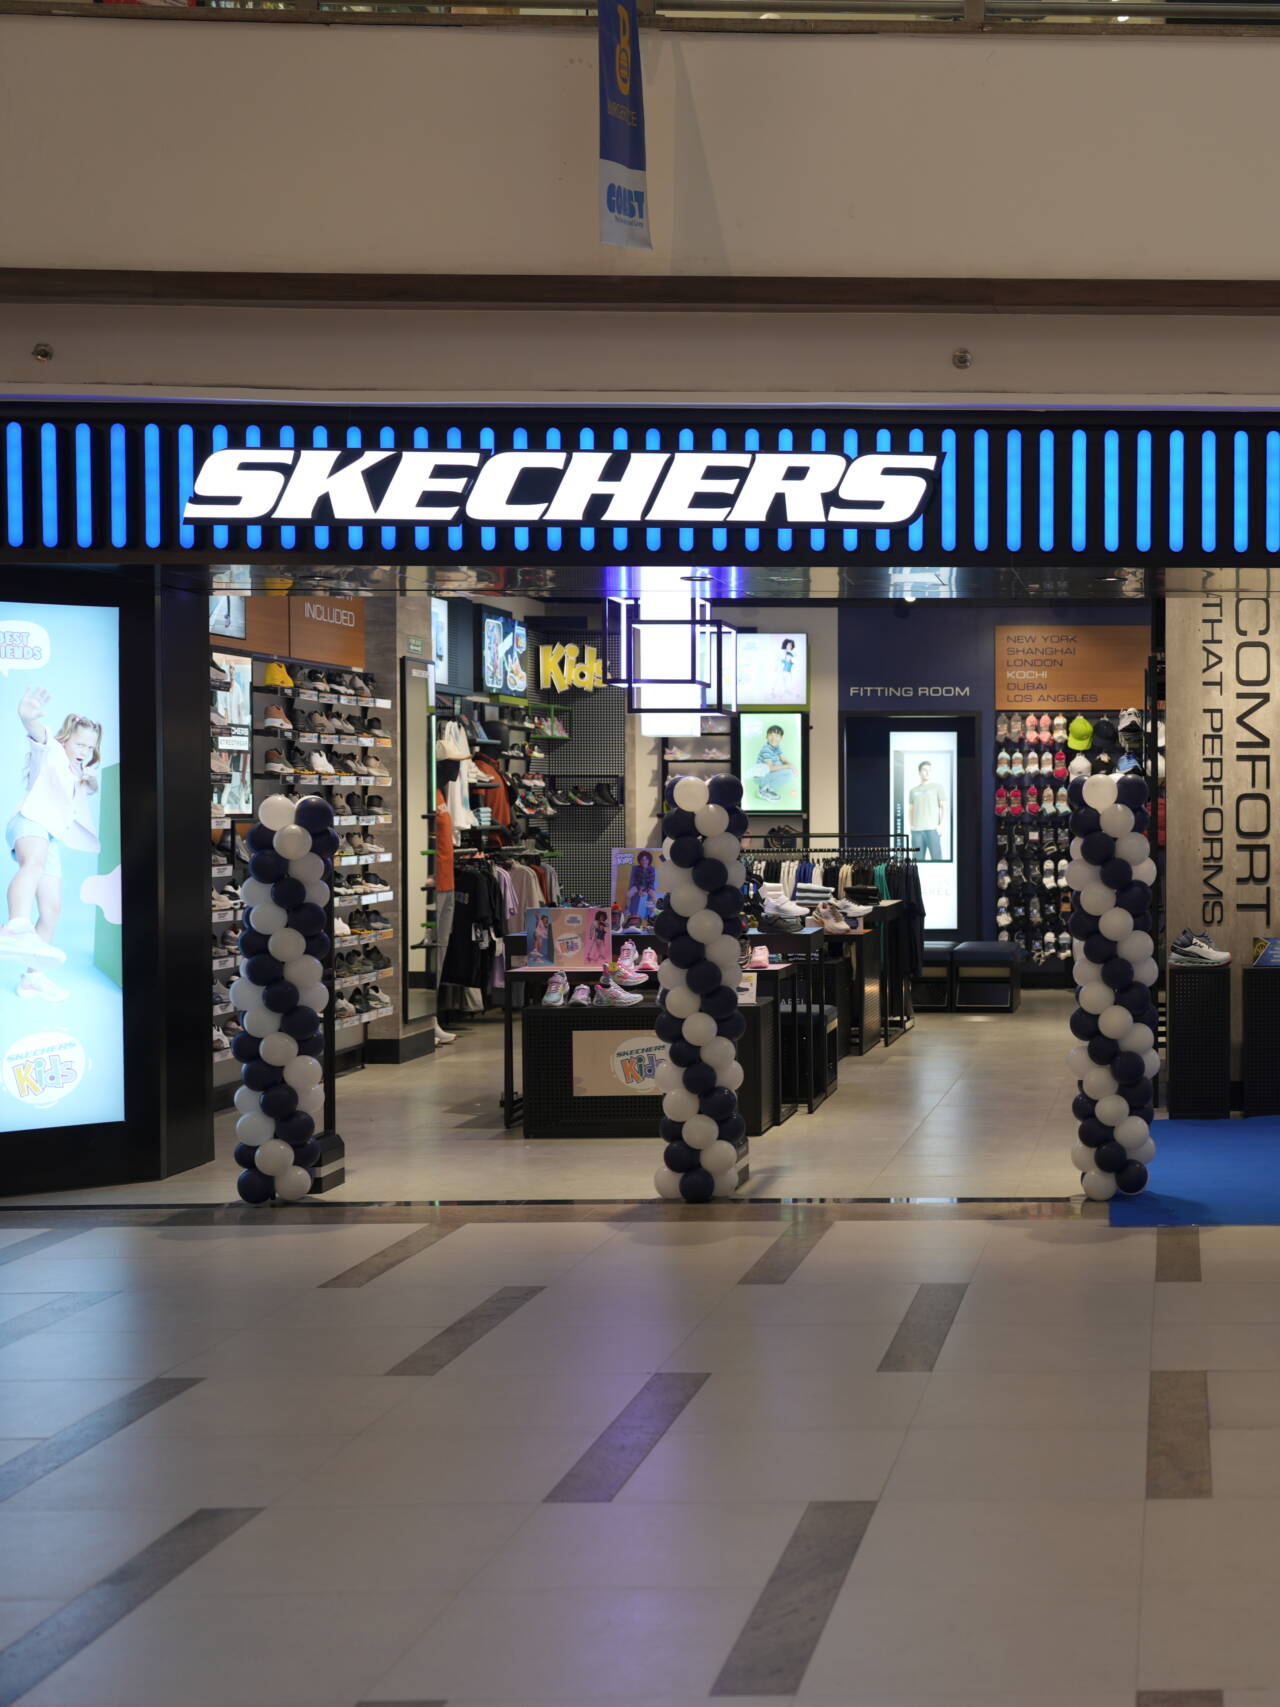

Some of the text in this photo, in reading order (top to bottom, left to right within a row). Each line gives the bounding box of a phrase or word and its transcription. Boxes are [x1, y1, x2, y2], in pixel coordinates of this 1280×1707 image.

[184, 448, 943, 523] SKECHERS
[304, 602, 355, 627] INCLUDED
[1007, 635, 1077, 643] NEW YORK
[1007, 647, 1076, 655] SHANGHAI
[539, 642, 611, 693] Kids
[1007, 659, 1063, 667] LONDON
[1007, 671, 1048, 679] KOCHI
[850, 686, 970, 697] FITTING ROOM
[1007, 683, 1048, 691] DUBAI
[1007, 694, 1098, 702] LOS ANGELES
[1201, 597, 1224, 927] THAT PERFORMS
[1235, 597, 1271, 928] COMFORT
[615, 1044, 666, 1058] SKECHERS
[12, 1054, 78, 1097] Kids
[621, 1054, 666, 1084] Kid
